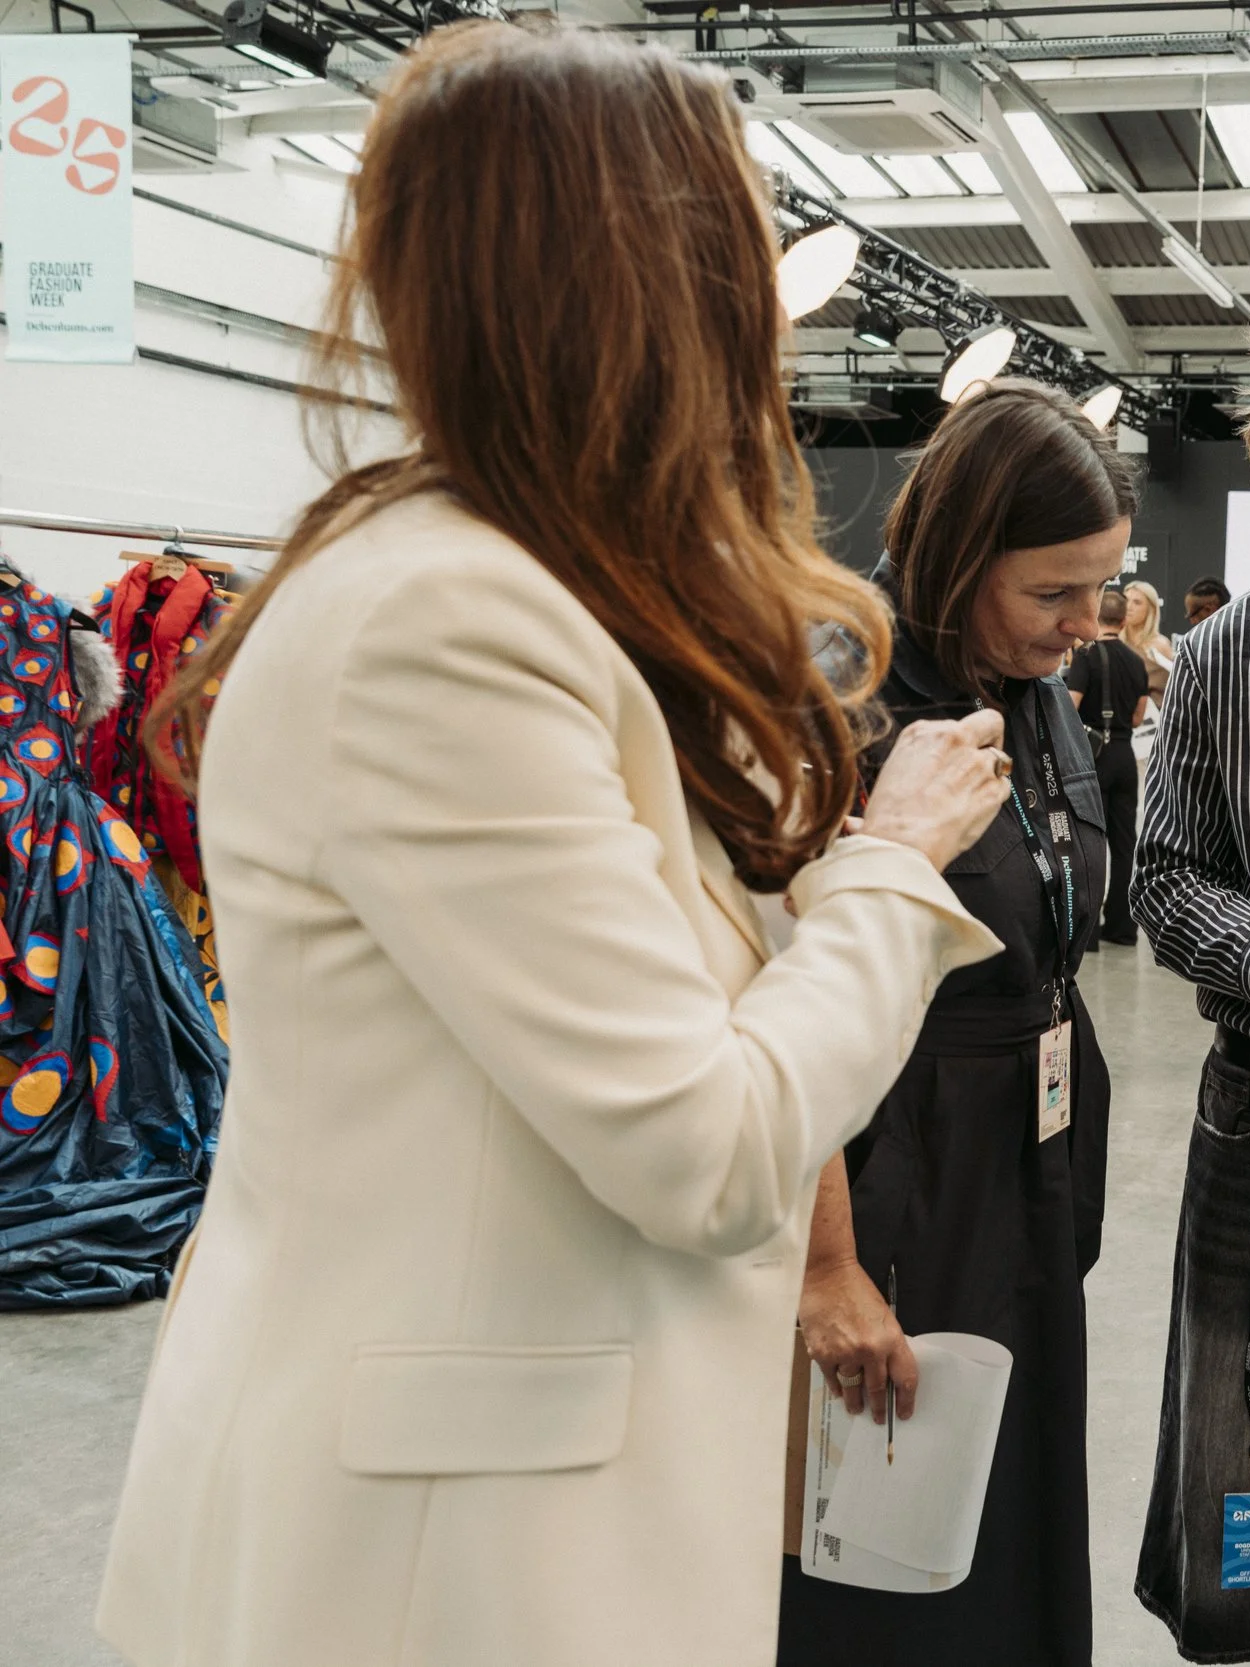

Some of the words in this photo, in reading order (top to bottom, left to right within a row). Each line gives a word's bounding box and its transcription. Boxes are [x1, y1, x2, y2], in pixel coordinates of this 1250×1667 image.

[29, 261, 94, 278] GRADUATE
[29, 277, 82, 293] FASHION
[31, 292, 65, 308] WEEK
[1060, 810, 1072, 842] GRADUATE
